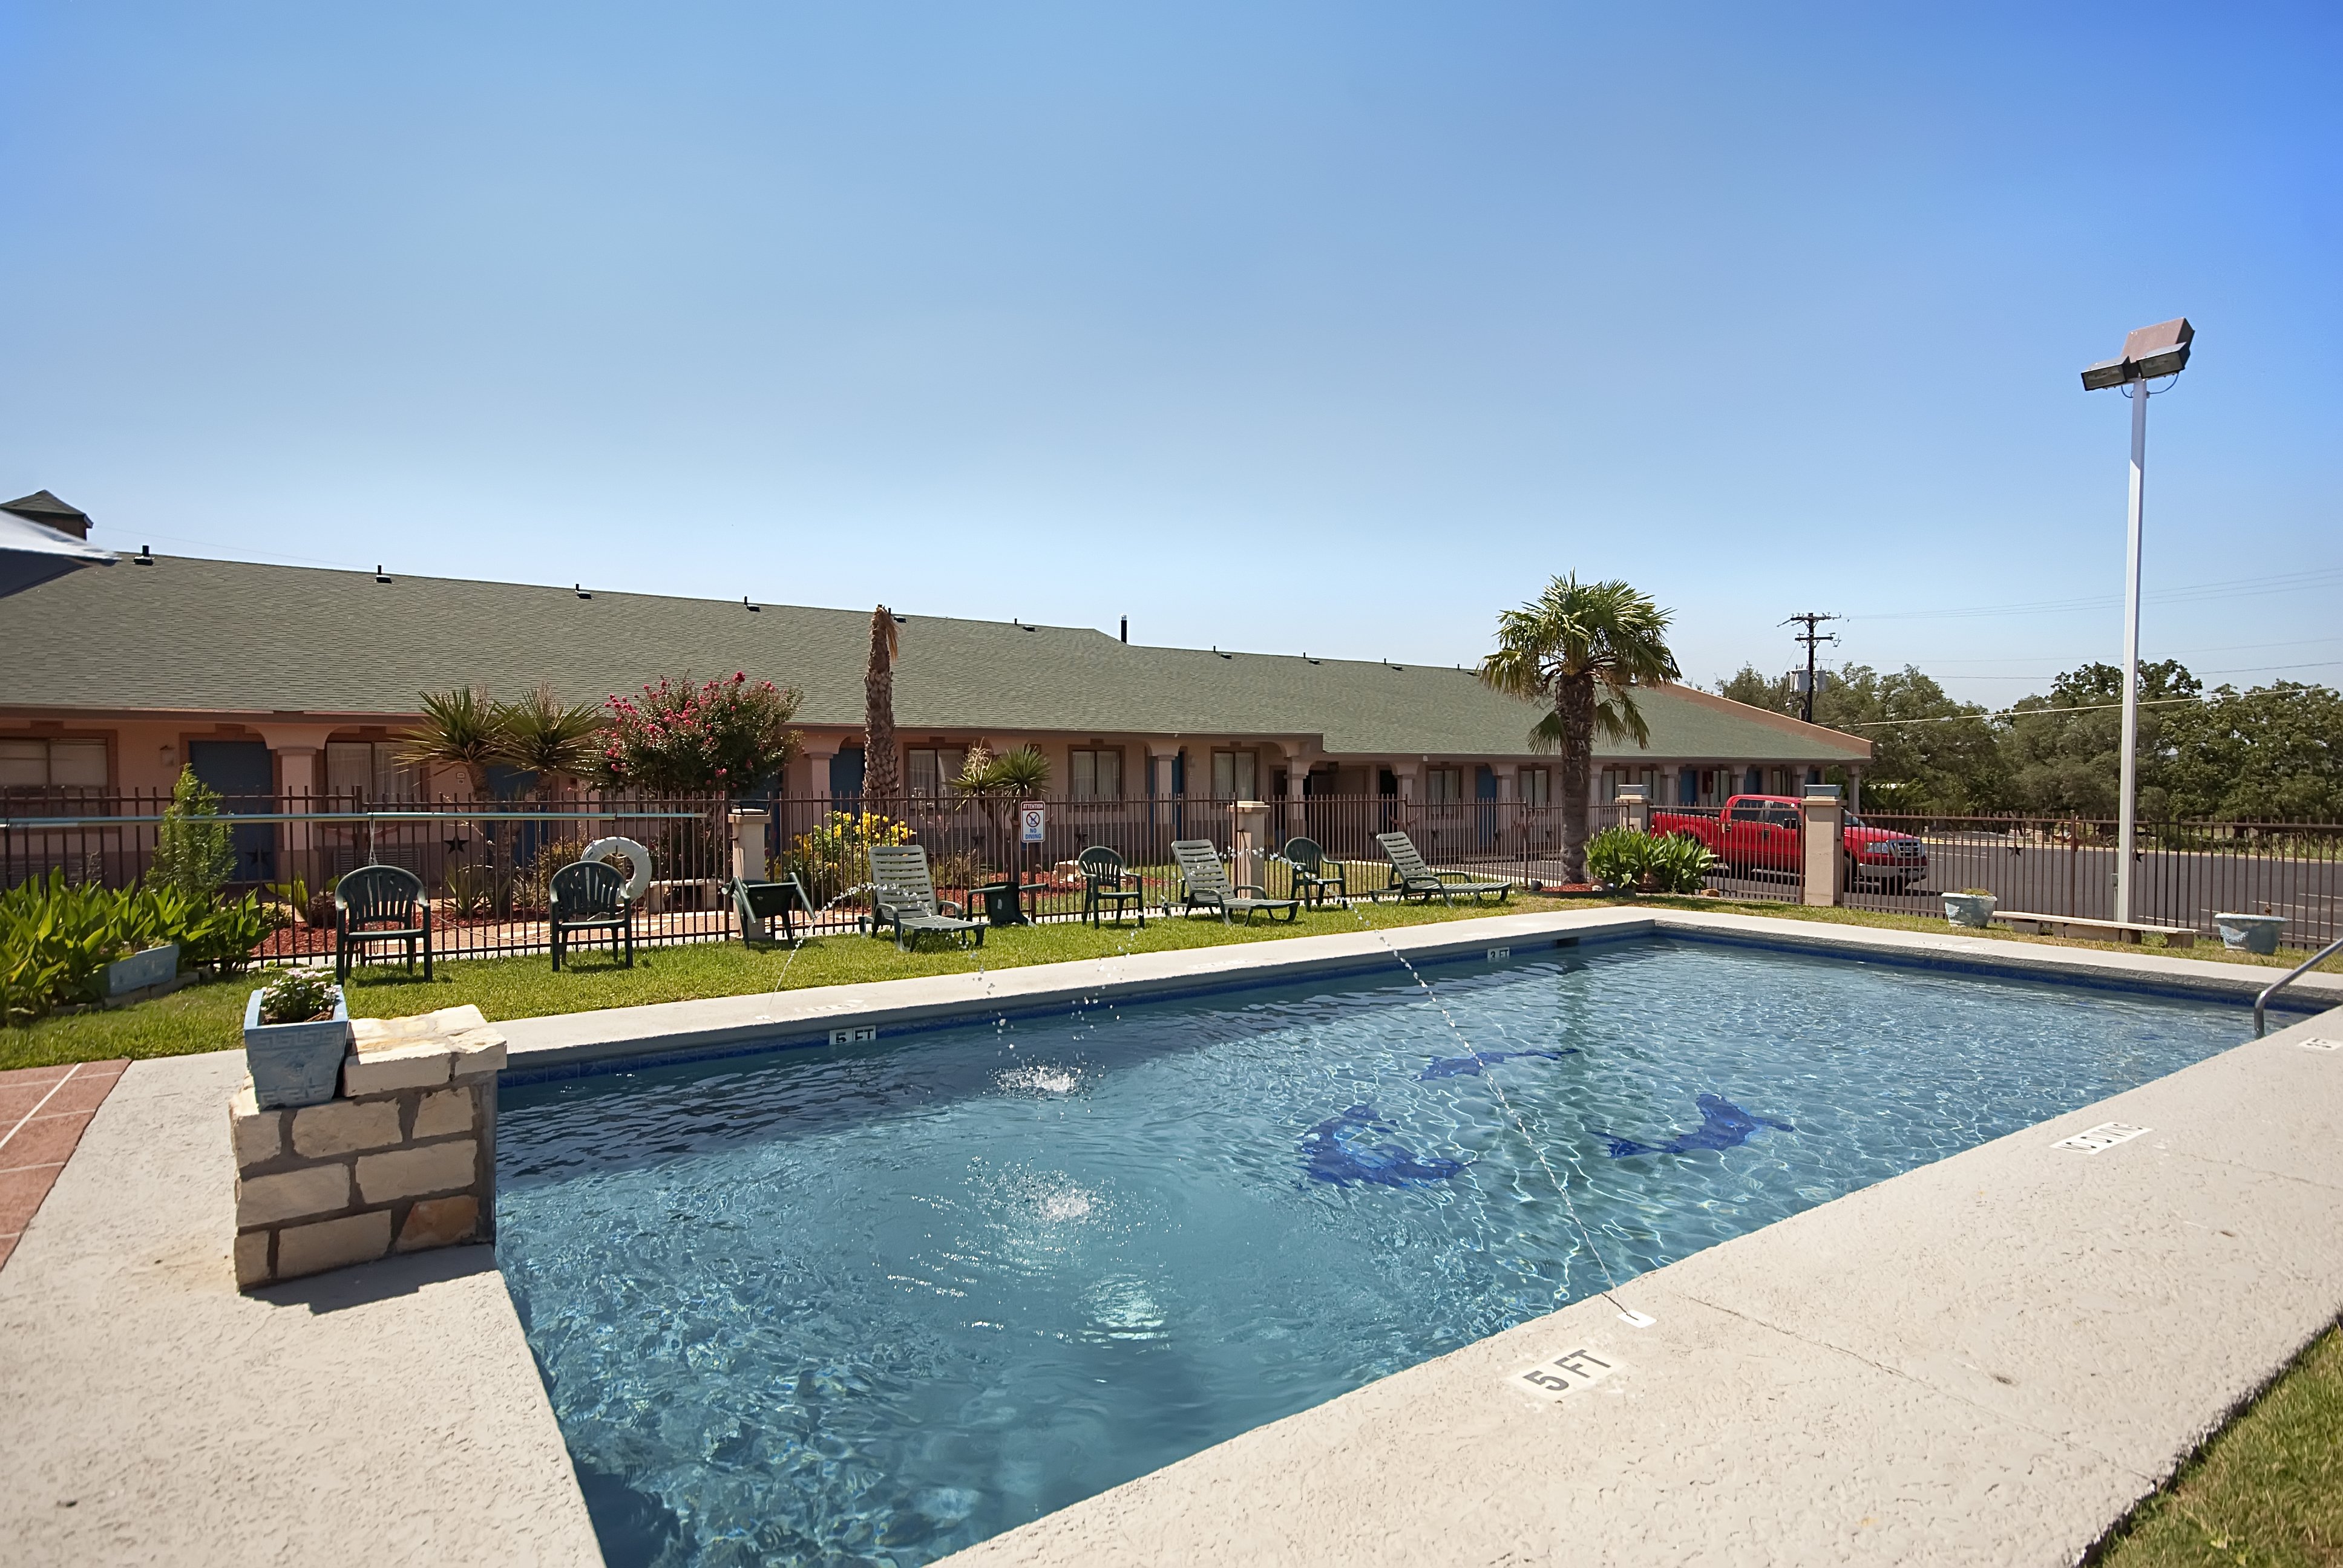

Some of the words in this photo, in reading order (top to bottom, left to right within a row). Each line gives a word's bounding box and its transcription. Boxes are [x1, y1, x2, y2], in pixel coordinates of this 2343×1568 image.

[1499, 949, 1509, 958] FT
[836, 1031, 847, 1043] 5
[854, 1028, 874, 1040] FT
[1522, 1370, 1569, 1391] 5
[1553, 1349, 1611, 1379] FT
